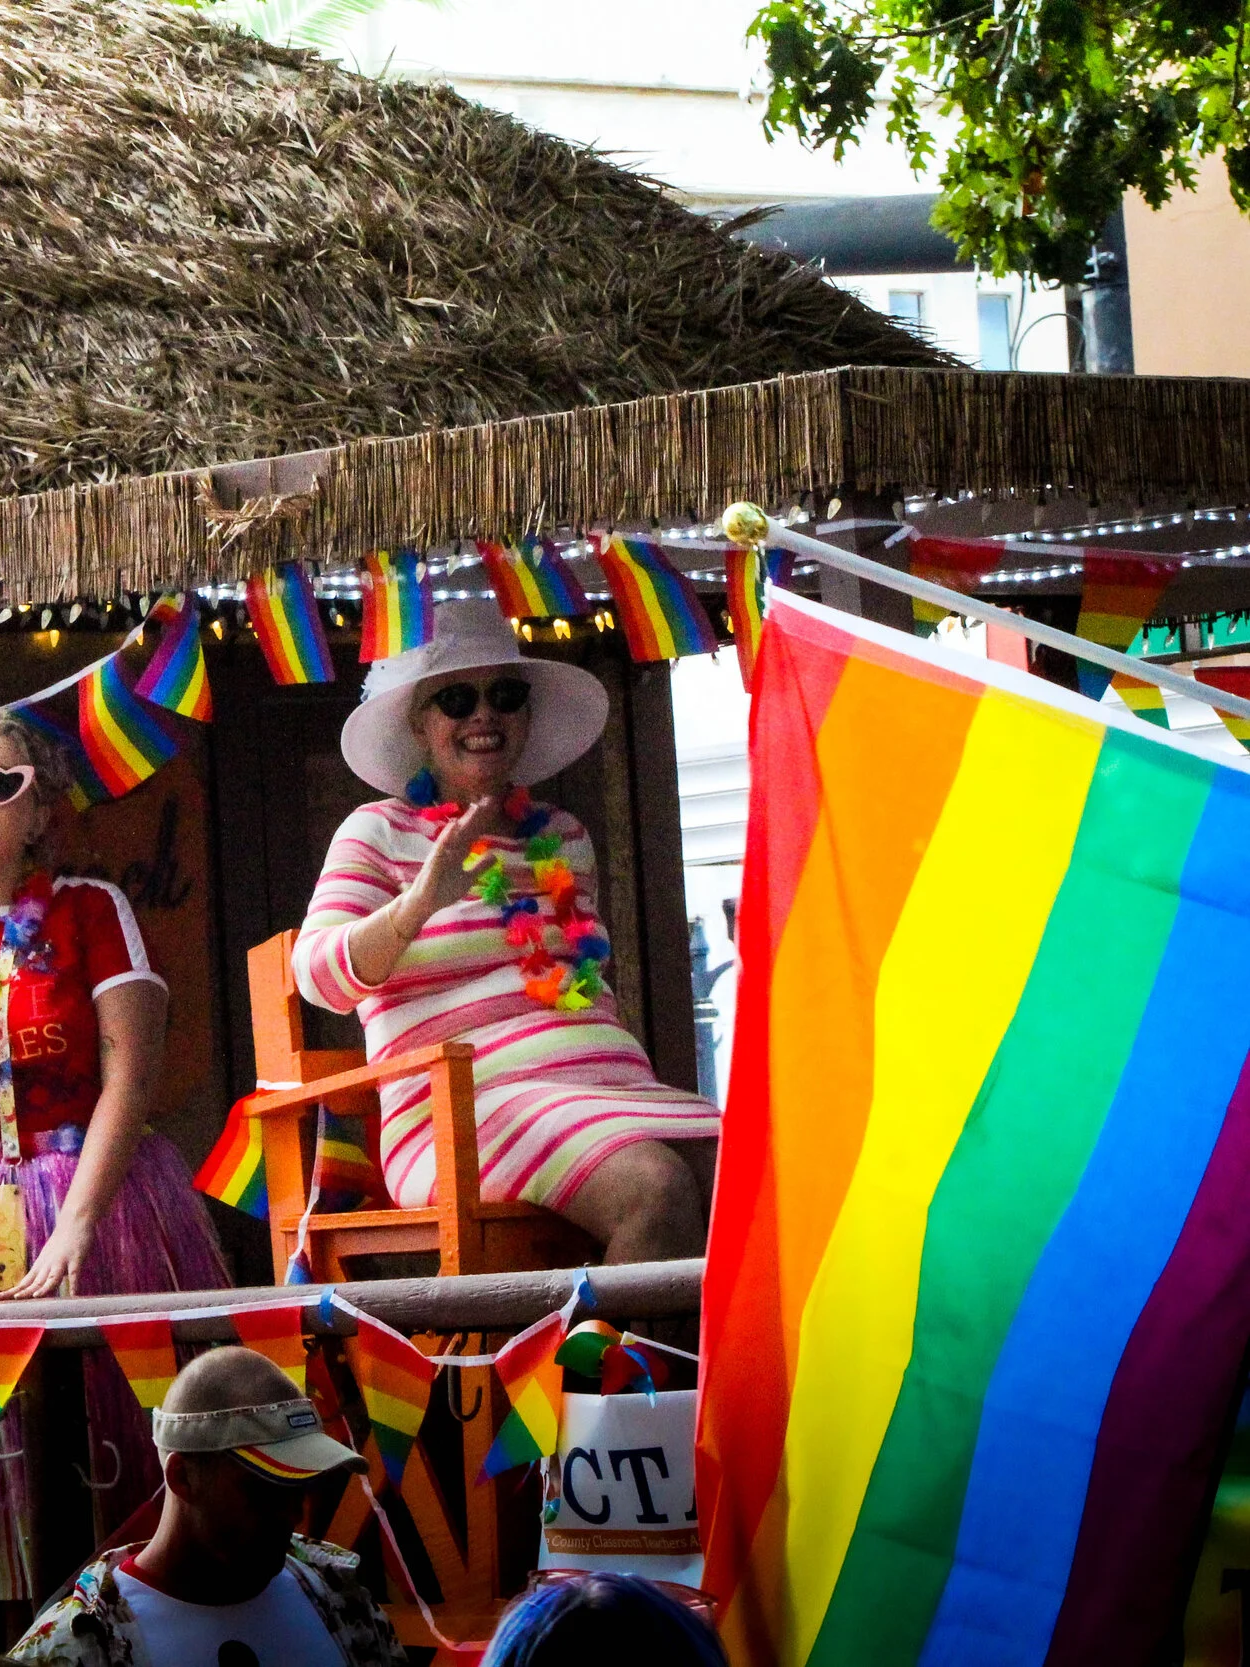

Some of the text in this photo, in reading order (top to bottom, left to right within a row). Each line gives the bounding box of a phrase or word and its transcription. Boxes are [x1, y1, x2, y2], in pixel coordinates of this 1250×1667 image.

[563, 1447, 699, 1525] CT
[551, 1535, 591, 1550] County
[593, 1535, 643, 1548] Classroom
[643, 1536, 687, 1548] Teachers
